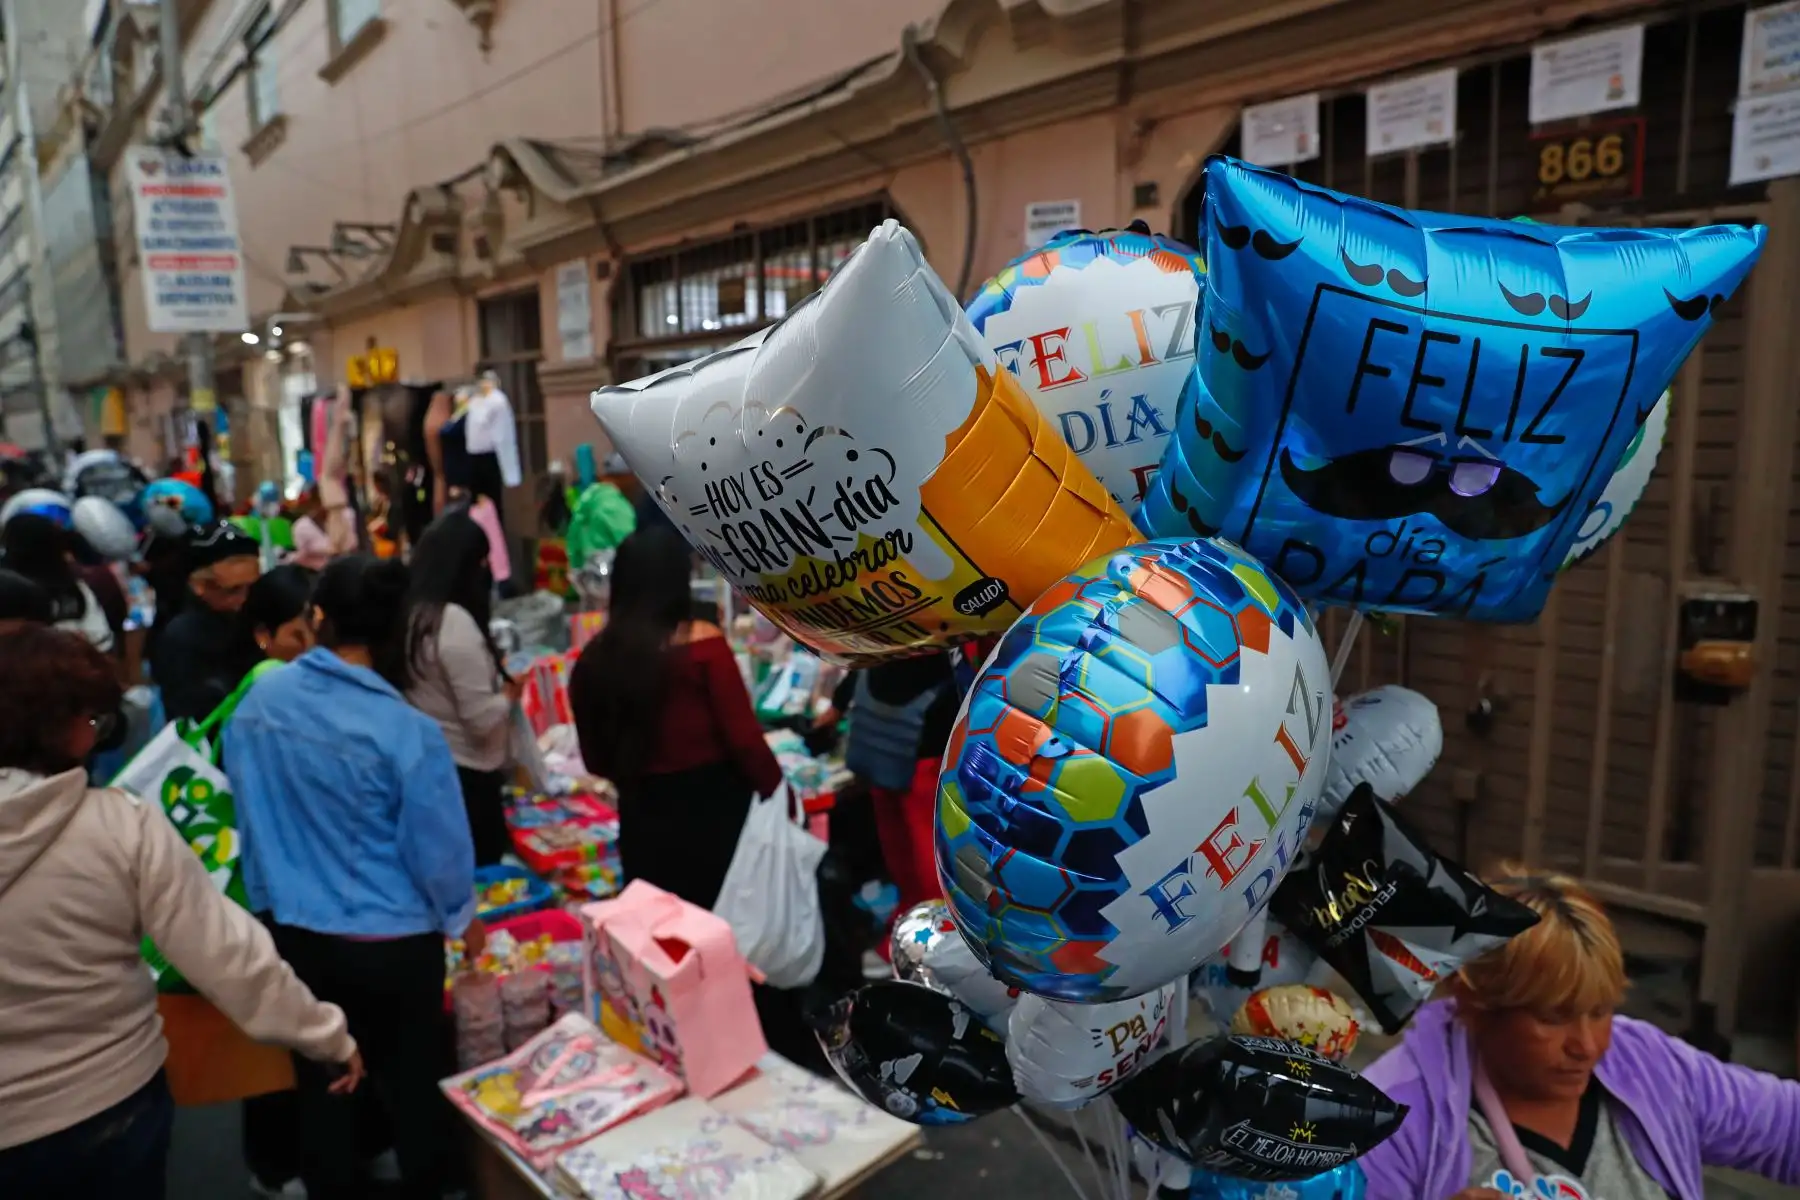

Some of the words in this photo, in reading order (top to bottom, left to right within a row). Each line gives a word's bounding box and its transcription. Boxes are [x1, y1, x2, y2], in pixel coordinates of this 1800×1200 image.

[1538, 134, 1624, 184] 866
[993, 300, 1196, 392] FELIZ
[1346, 317, 1586, 445] FELIZ
[1057, 388, 1172, 457] DÍA
[704, 471, 753, 520] HOY
[750, 460, 785, 501] ES
[787, 528, 913, 599] celebrar
[1364, 519, 1447, 565] día
[960, 580, 1005, 616] SALUD!
[1140, 659, 1323, 936] FELIZ
[1227, 1127, 1249, 1149] EL
[1250, 1136, 1298, 1165] MEJOR
